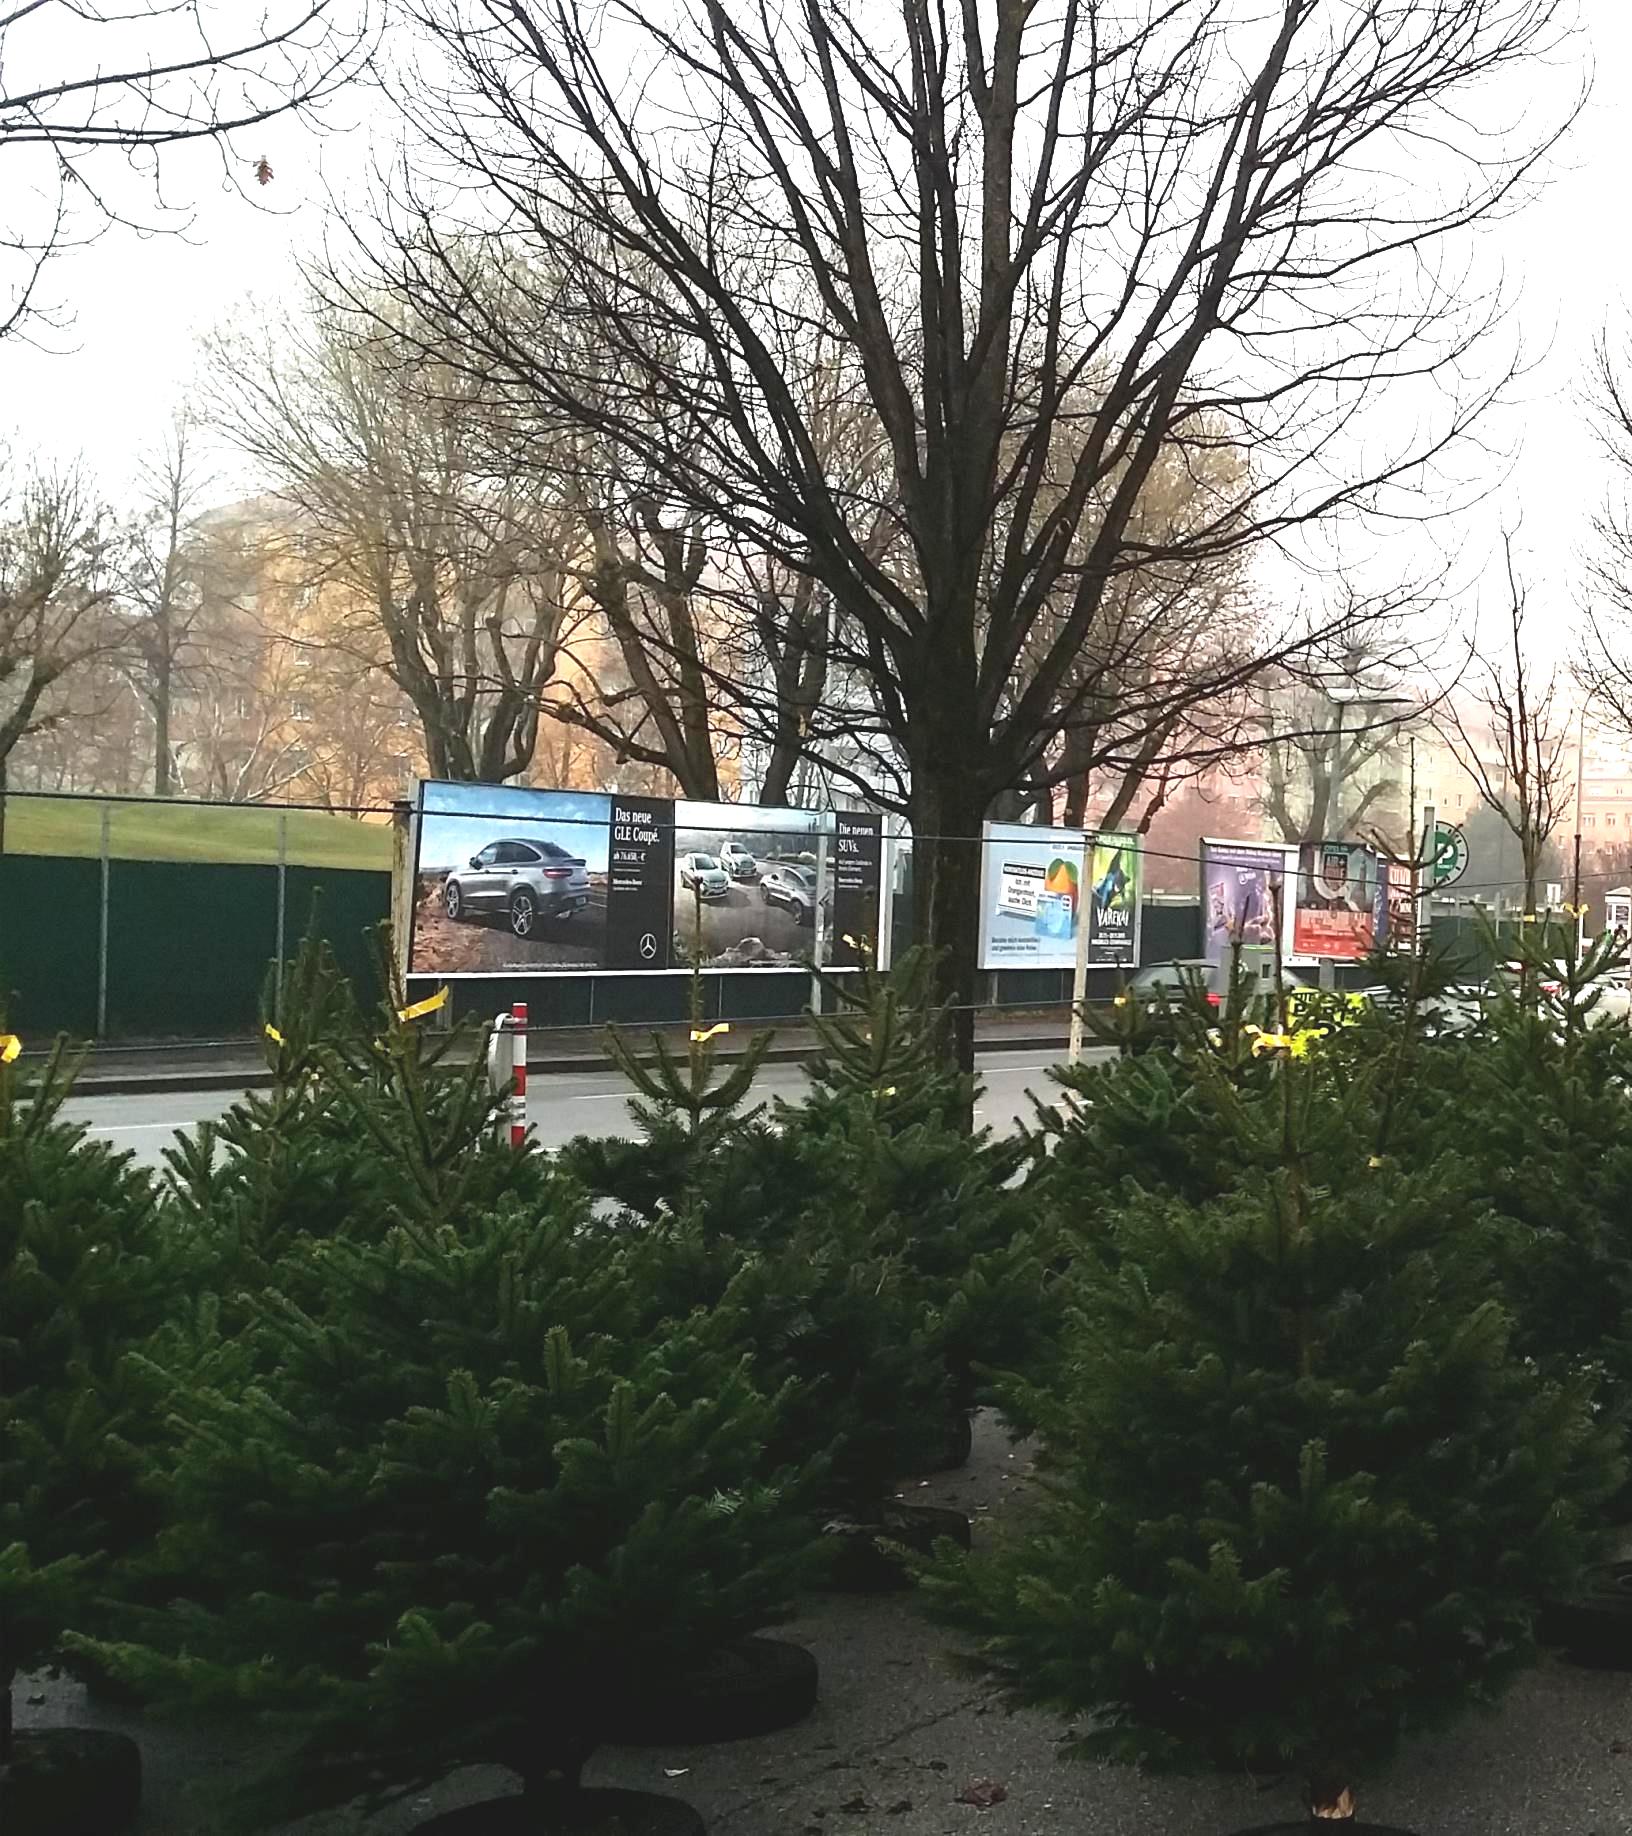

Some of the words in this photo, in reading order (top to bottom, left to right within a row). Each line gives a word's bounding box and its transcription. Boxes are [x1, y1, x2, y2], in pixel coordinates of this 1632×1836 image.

[616, 807, 630, 822] Das
[632, 811, 652, 824] neue
[614, 826, 631, 840] GLE
[632, 828, 660, 846] Coupé.
[840, 822, 850, 835] Die
[1097, 907, 1128, 926] VAREKAI
